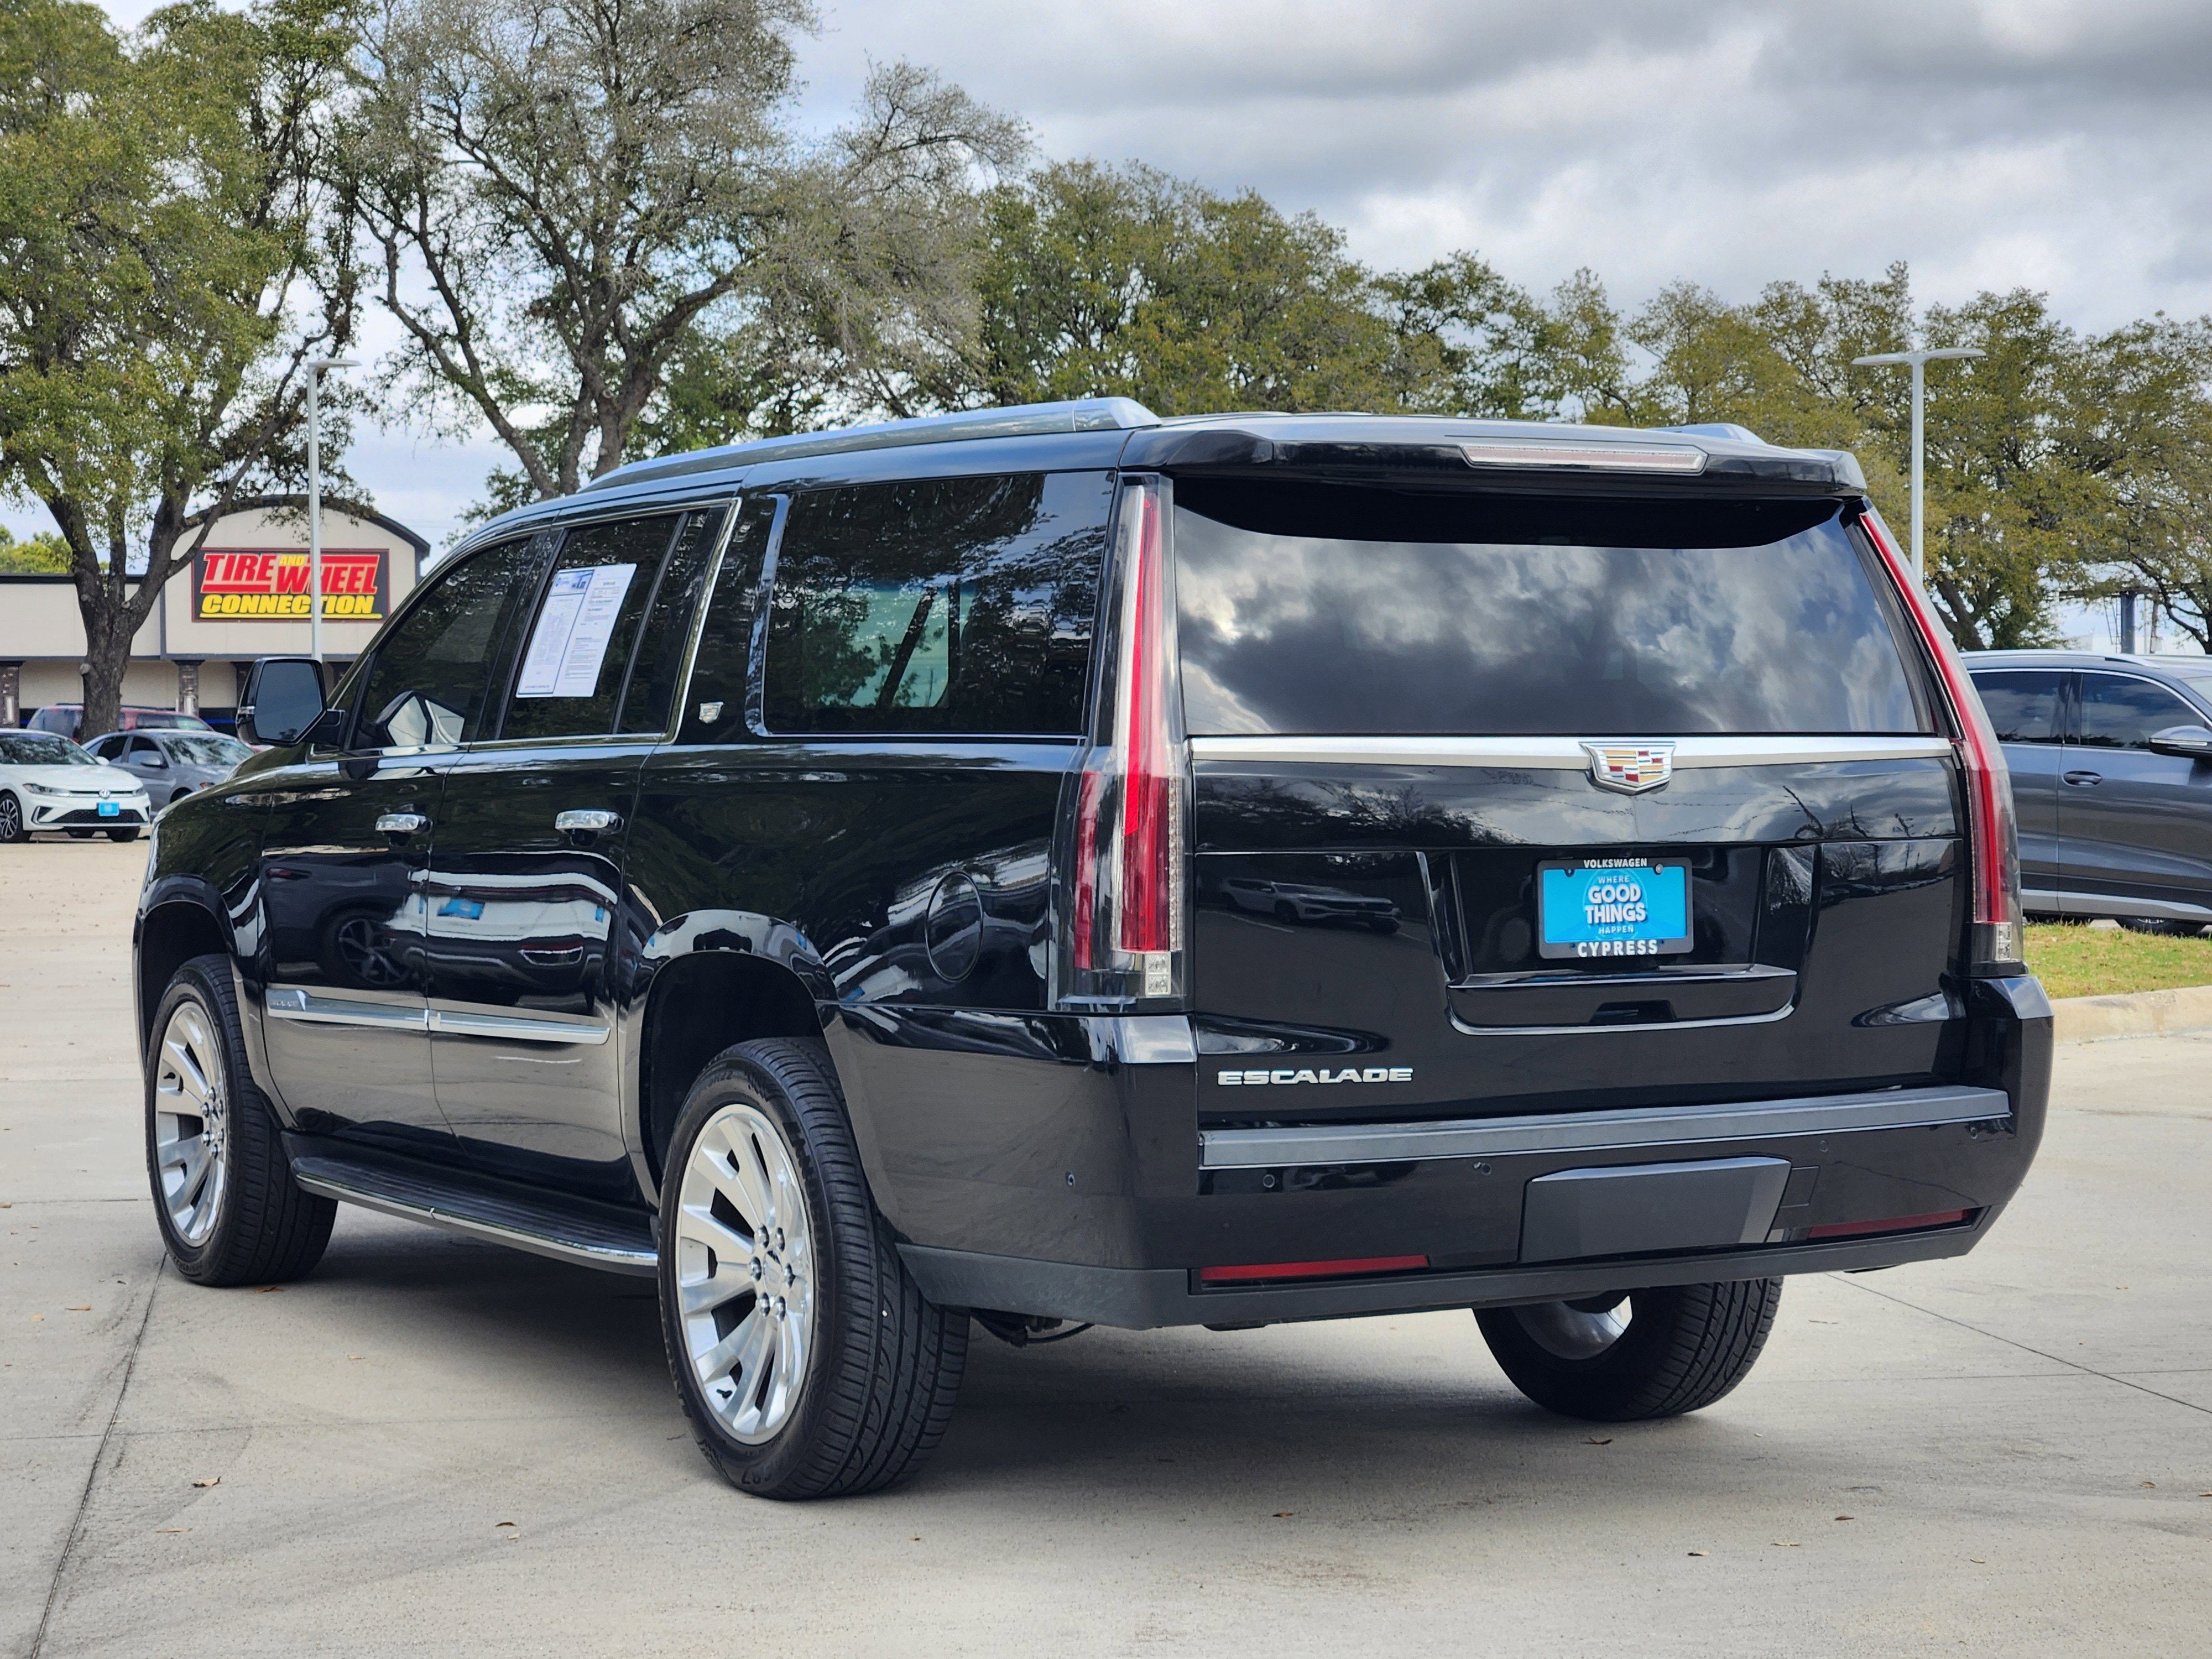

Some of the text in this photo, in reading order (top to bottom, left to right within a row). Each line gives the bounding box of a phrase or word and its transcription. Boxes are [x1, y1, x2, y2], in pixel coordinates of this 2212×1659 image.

[204, 554, 277, 581] TIRE
[279, 555, 306, 566] AND
[1584, 858, 1647, 868] VOLKSWAGEN
[1598, 875, 1630, 884] WHERE
[1588, 884, 1641, 904] GOOD
[1584, 902, 1647, 924] THINGS
[1598, 925, 1634, 935] HAPPEN
[1577, 940, 1658, 957] CYPRESS
[1217, 1068, 1413, 1086] ESCALADE
